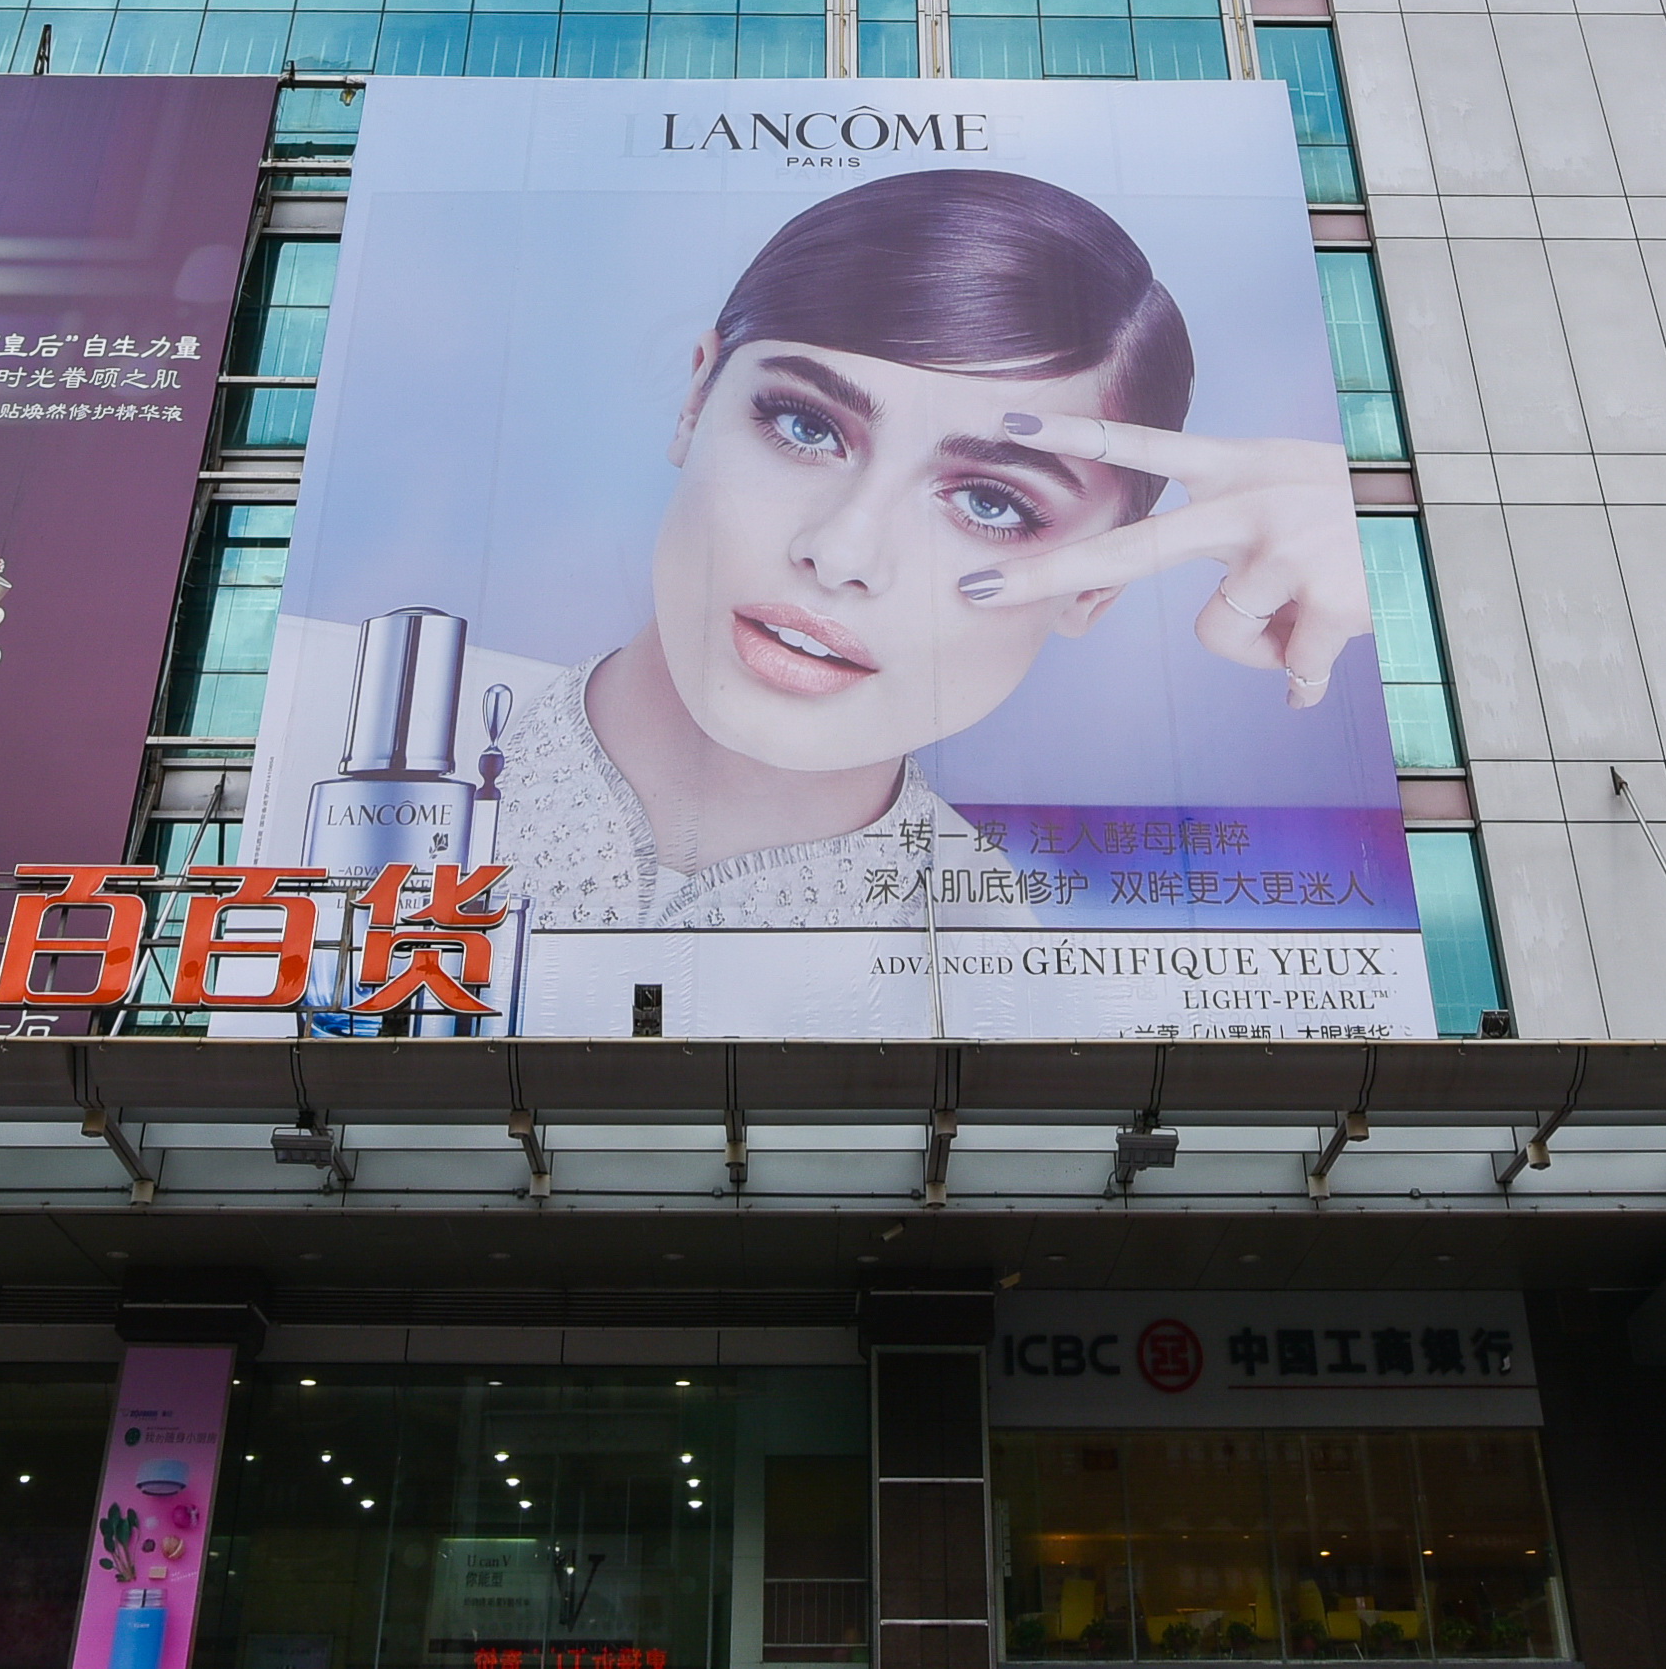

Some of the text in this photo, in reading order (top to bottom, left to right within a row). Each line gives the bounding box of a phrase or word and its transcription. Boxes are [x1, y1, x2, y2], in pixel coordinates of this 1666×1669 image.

[661, 104, 989, 152] LANCÔME
[786, 156, 861, 168] PARIS
[326, 800, 453, 827] LANCÔME
[863, 819, 1251, 857] 一转一按 注入酵母精粹
[863, 868, 1376, 907] 深入肌底修护 双眸更大更迷人
[1022, 938, 1259, 982] GÉNIFIQUE
[1271, 946, 1384, 976] YEUX
[1001, 1327, 1514, 1377] ICBC 中国工商银行
